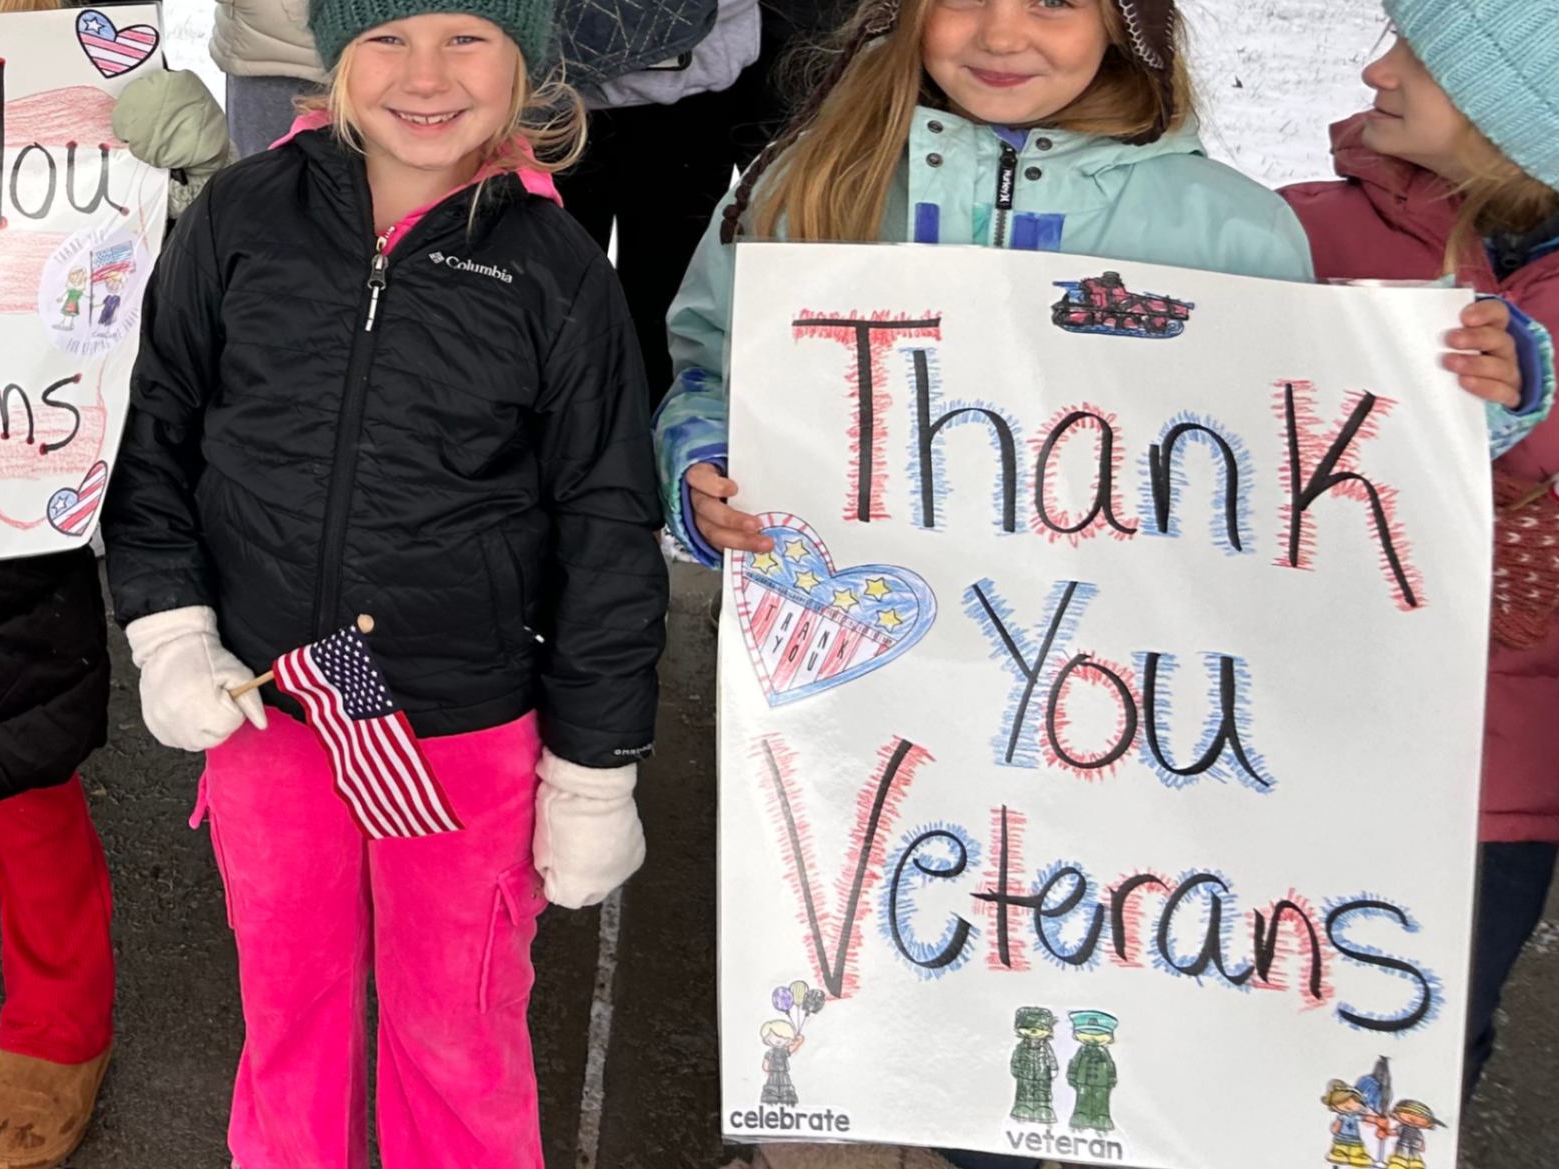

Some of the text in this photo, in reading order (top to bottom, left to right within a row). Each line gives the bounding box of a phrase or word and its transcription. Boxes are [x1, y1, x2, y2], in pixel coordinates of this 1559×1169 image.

[446, 255, 514, 284] Columbia
[968, 578, 1277, 793] You
[760, 735, 1441, 1035] Veterans
[729, 1106, 851, 1133] celebrate
[1005, 1127, 1124, 1161] veteran
